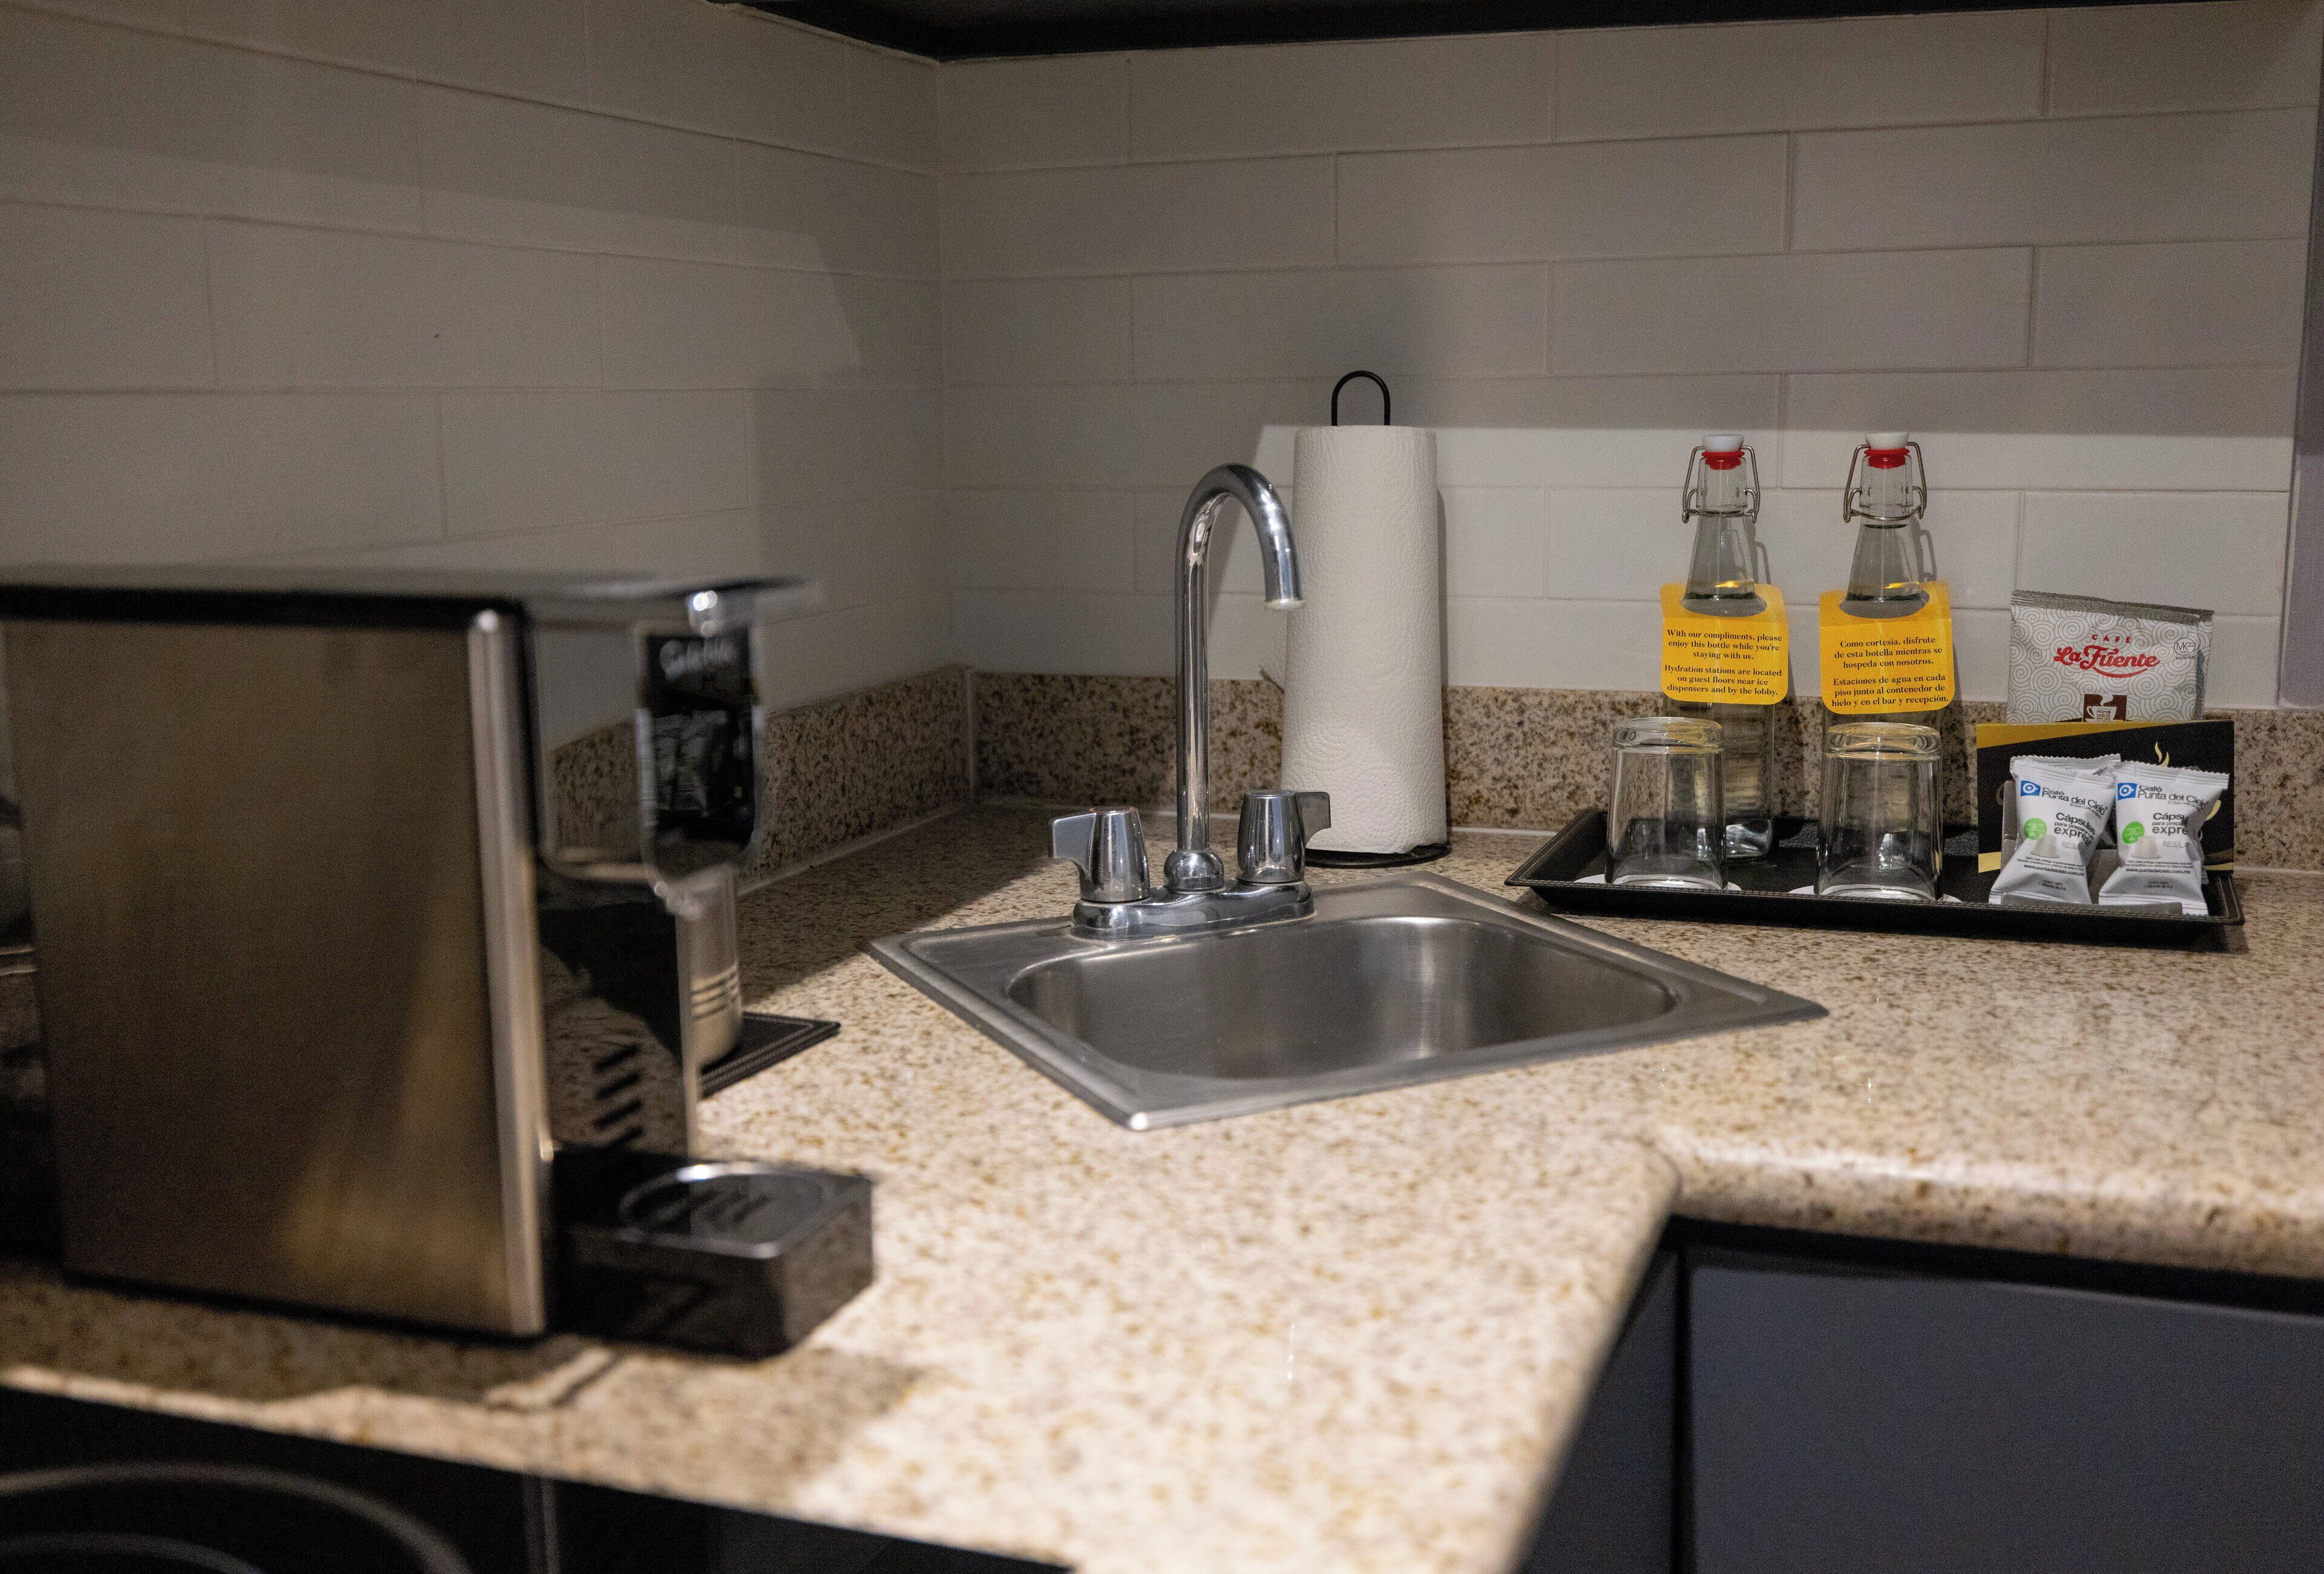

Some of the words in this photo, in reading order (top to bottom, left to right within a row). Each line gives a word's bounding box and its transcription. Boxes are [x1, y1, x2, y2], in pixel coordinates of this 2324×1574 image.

[2092, 634, 2131, 644] CAFÉ
[2054, 647, 2082, 665] La
[2079, 645, 2160, 670] Fuente
[1665, 665, 1703, 673] Hydration
[1843, 660, 1877, 670] hospeda
[1667, 684, 1709, 693] dispensers
[1834, 689, 1851, 698] piso
[1854, 688, 1874, 696] junto
[2043, 787, 2064, 795] Café
[2138, 790, 2166, 800] Punta
[2042, 790, 2069, 802] Punta
[2071, 796, 2086, 805] del
